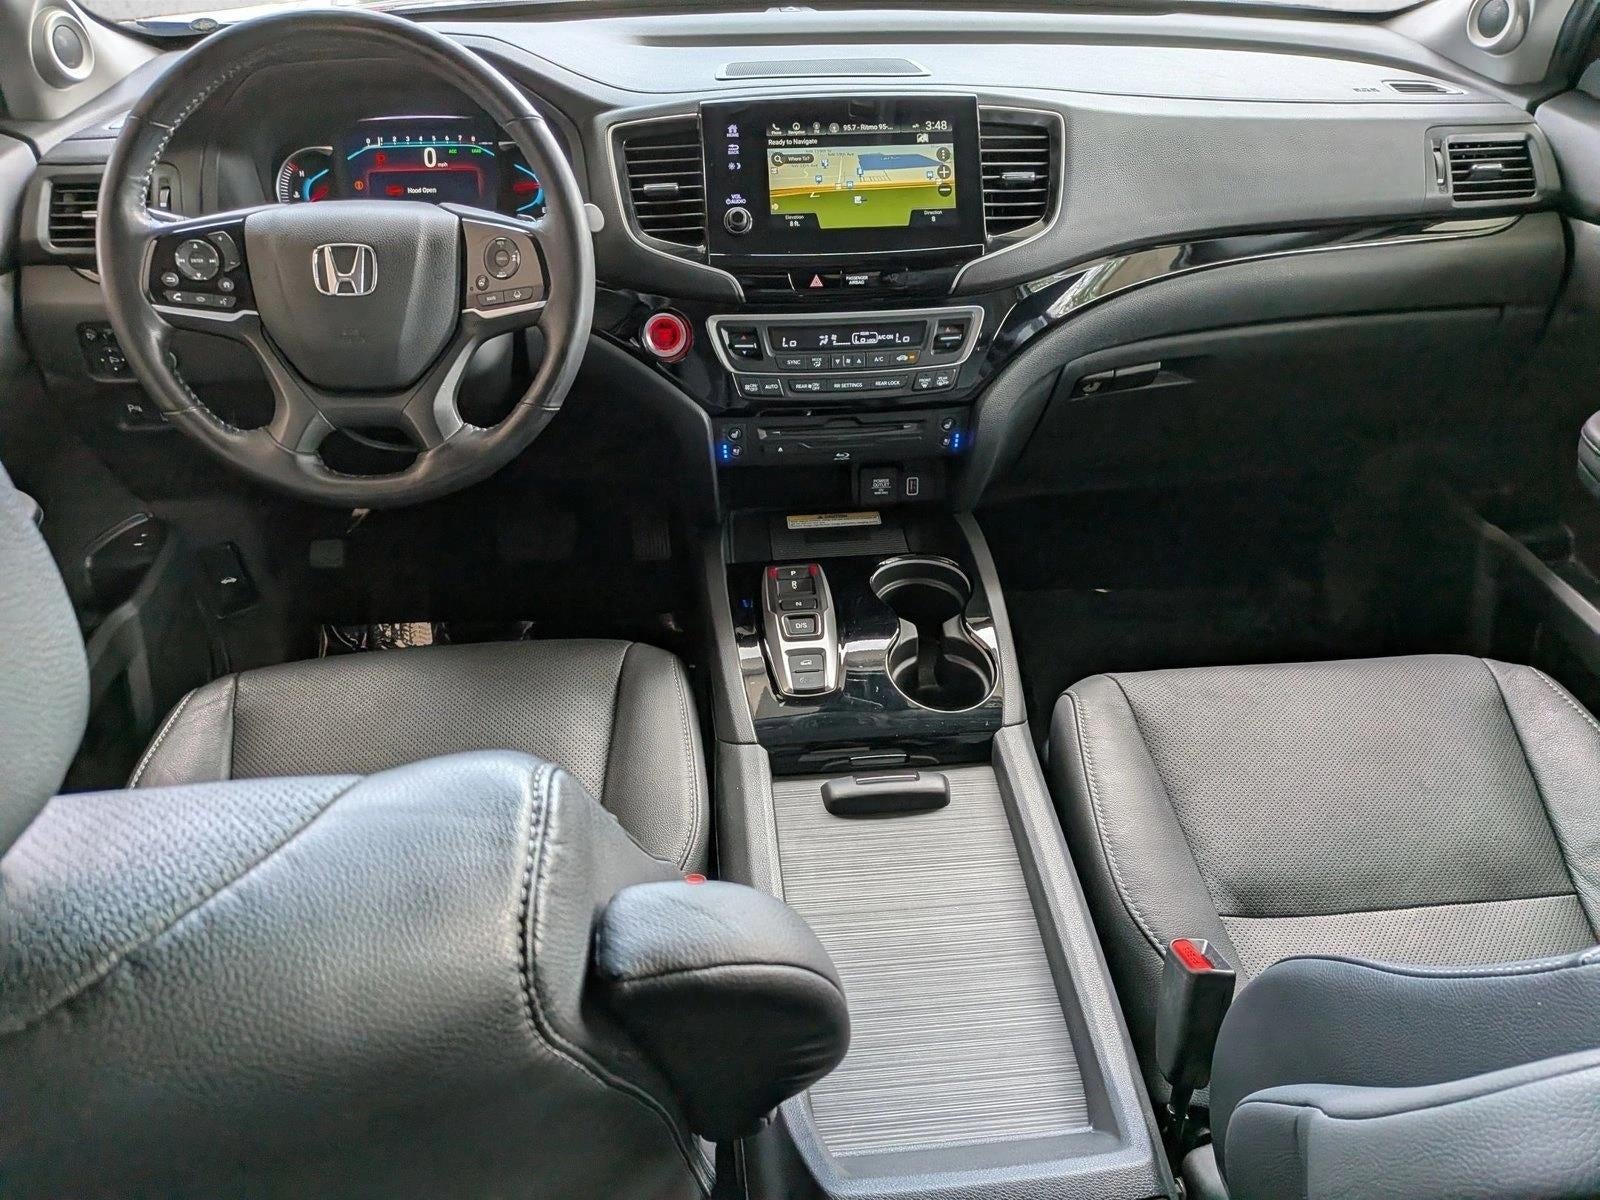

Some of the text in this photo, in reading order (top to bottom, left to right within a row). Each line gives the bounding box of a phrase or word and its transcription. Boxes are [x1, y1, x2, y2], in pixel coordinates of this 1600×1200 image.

[860, 123, 878, 131] Ritmo
[925, 120, 948, 131] 3:48
[793, 138, 818, 146] Navigate
[423, 147, 437, 168] 0
